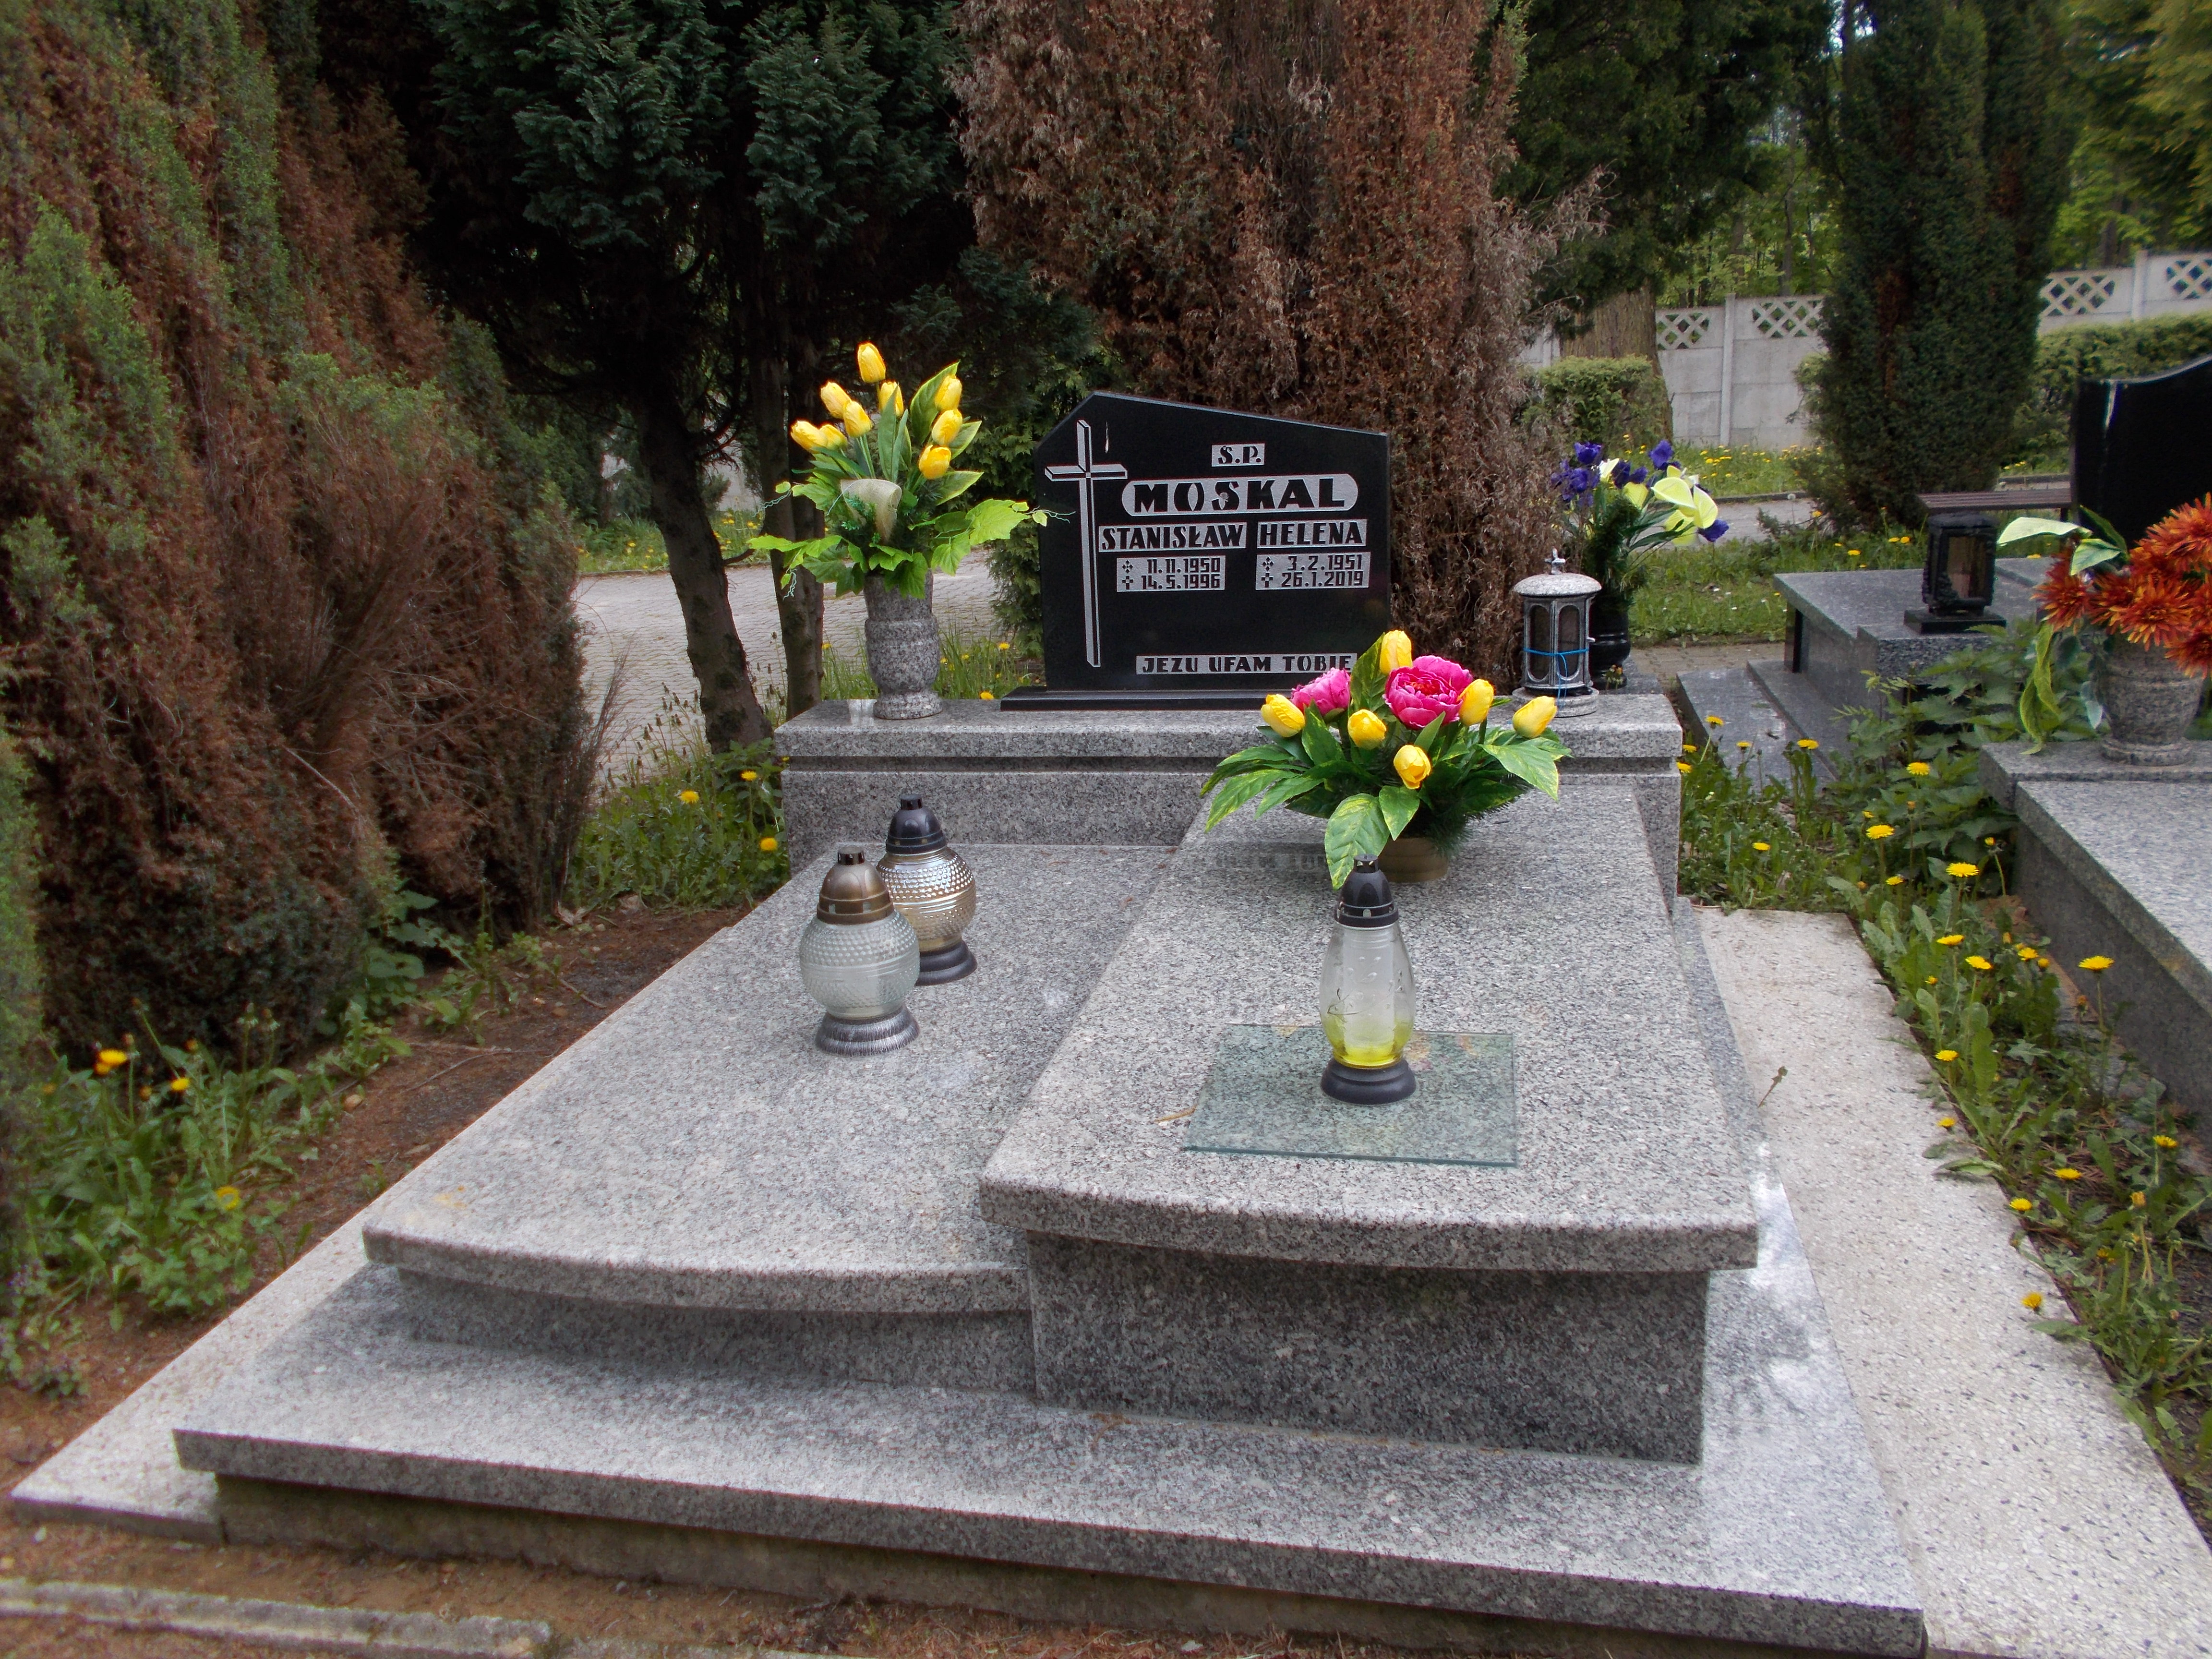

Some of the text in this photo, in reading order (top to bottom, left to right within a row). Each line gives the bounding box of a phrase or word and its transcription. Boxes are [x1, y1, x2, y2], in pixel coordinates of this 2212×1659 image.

[1133, 479, 1345, 513] MOSKAL
[1102, 525, 1244, 550] STANISŁAW
[1260, 522, 1363, 546] HELENA
[1147, 557, 1221, 574] 11.11.1950
[1287, 554, 1362, 571] 3.2.1951
[1141, 574, 1220, 589] 14.5.1996
[1281, 571, 1363, 587] 26.1.2019
[1142, 655, 1351, 673] JEZU UFAM TOBIE
